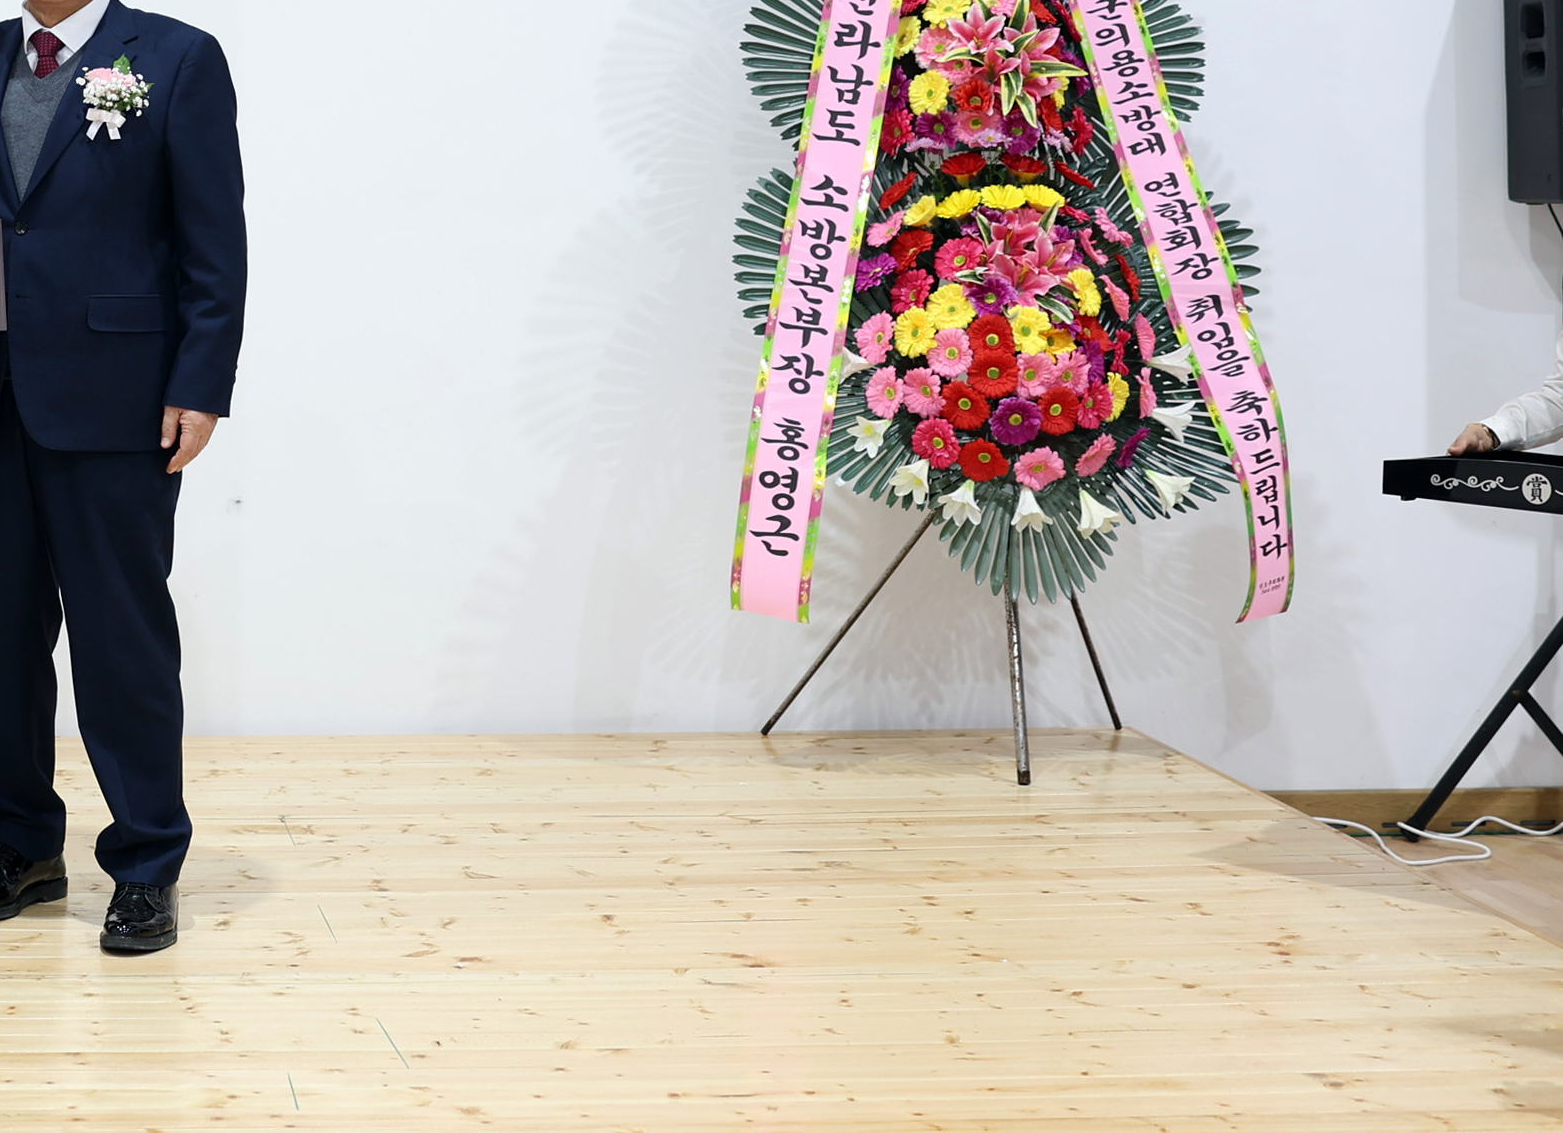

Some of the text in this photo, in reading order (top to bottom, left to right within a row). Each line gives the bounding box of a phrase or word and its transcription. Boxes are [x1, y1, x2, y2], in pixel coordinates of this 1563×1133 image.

[771, 174, 850, 395] 소방본부장
[1143, 172, 1220, 281] 연합회장
[1185, 294, 1251, 376] 취임을
[1225, 390, 1288, 560] 축하드립니다
[748, 417, 809, 557] 홍영근
